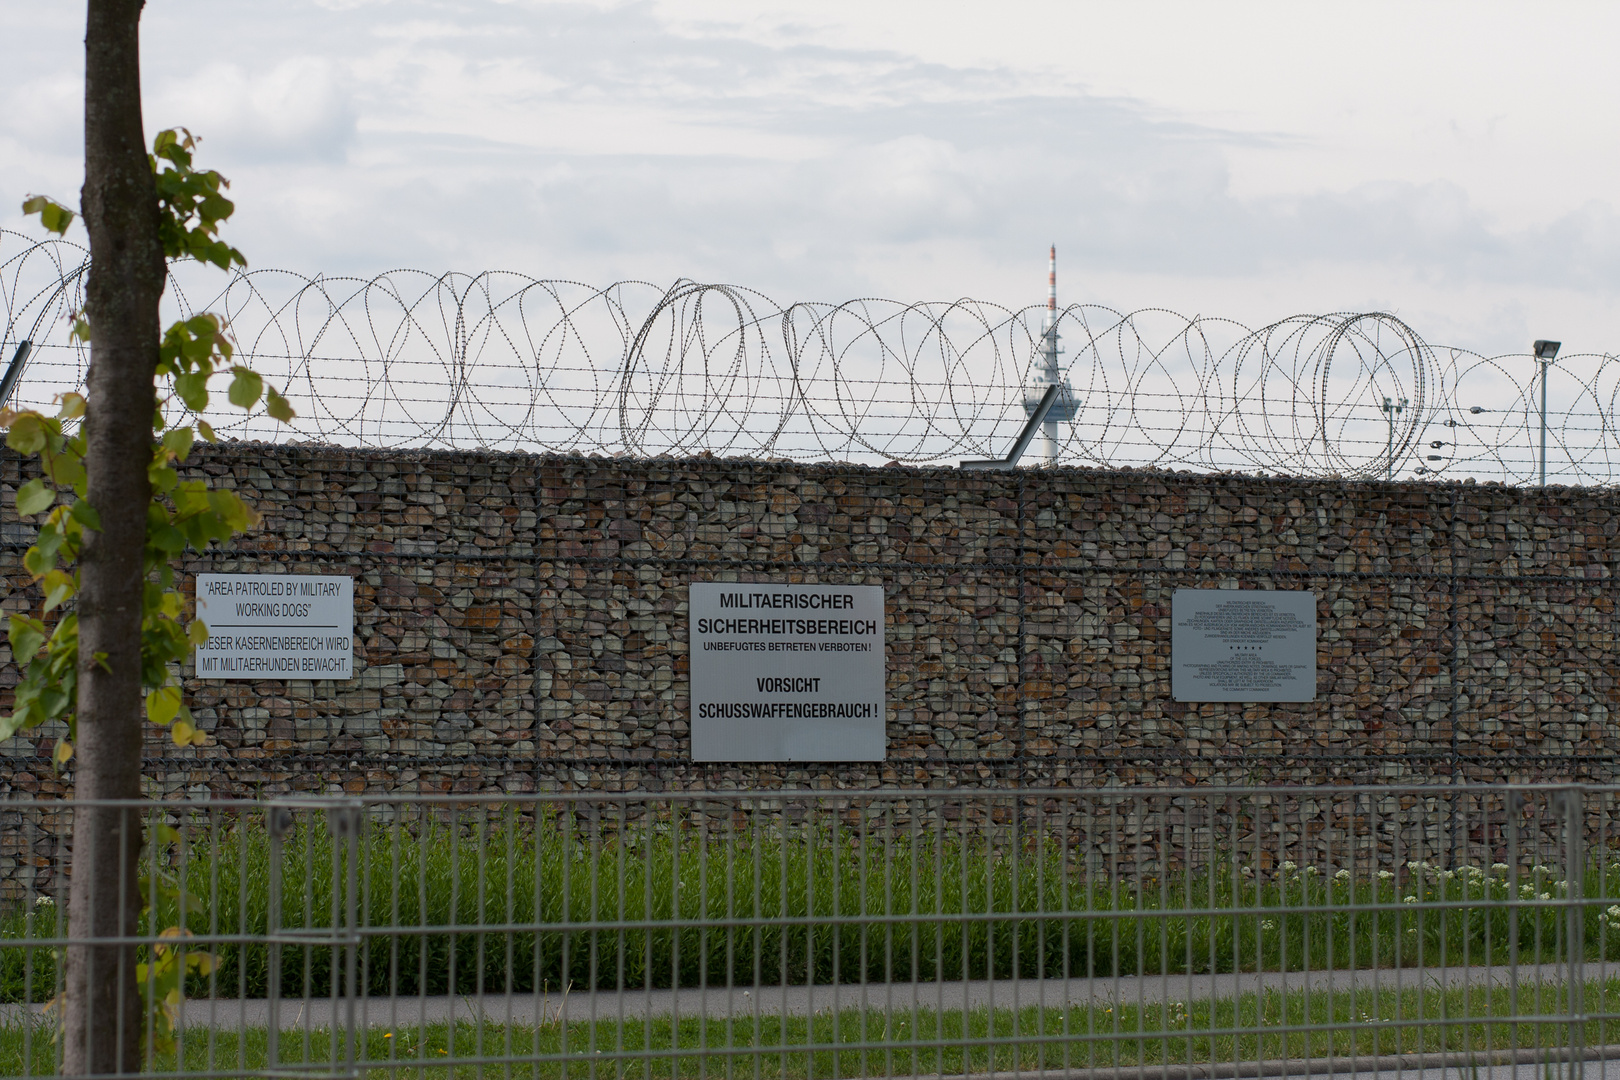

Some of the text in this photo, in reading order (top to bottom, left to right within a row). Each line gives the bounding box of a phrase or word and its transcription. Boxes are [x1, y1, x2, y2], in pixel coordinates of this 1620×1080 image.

[236, 582, 284, 596] PATROLED
[286, 583, 298, 596] BY
[300, 582, 342, 596] MILITARY
[719, 593, 853, 609] MILITAERISCHER
[236, 603, 280, 617] WORKING
[698, 618, 877, 635] SICHERHEITSBEREICH
[235, 637, 322, 650] KASERNENBEREICH
[326, 637, 349, 650] WIRD
[703, 642, 766, 651] UNBEFUGTES
[768, 642, 816, 652] BETRETEN
[202, 658, 348, 672] MIT MILITAERHUNDEN BEWACHT.
[757, 678, 820, 692] VORSICHT
[698, 704, 871, 718] SCHUSSWAFFENGEBRAUCH
